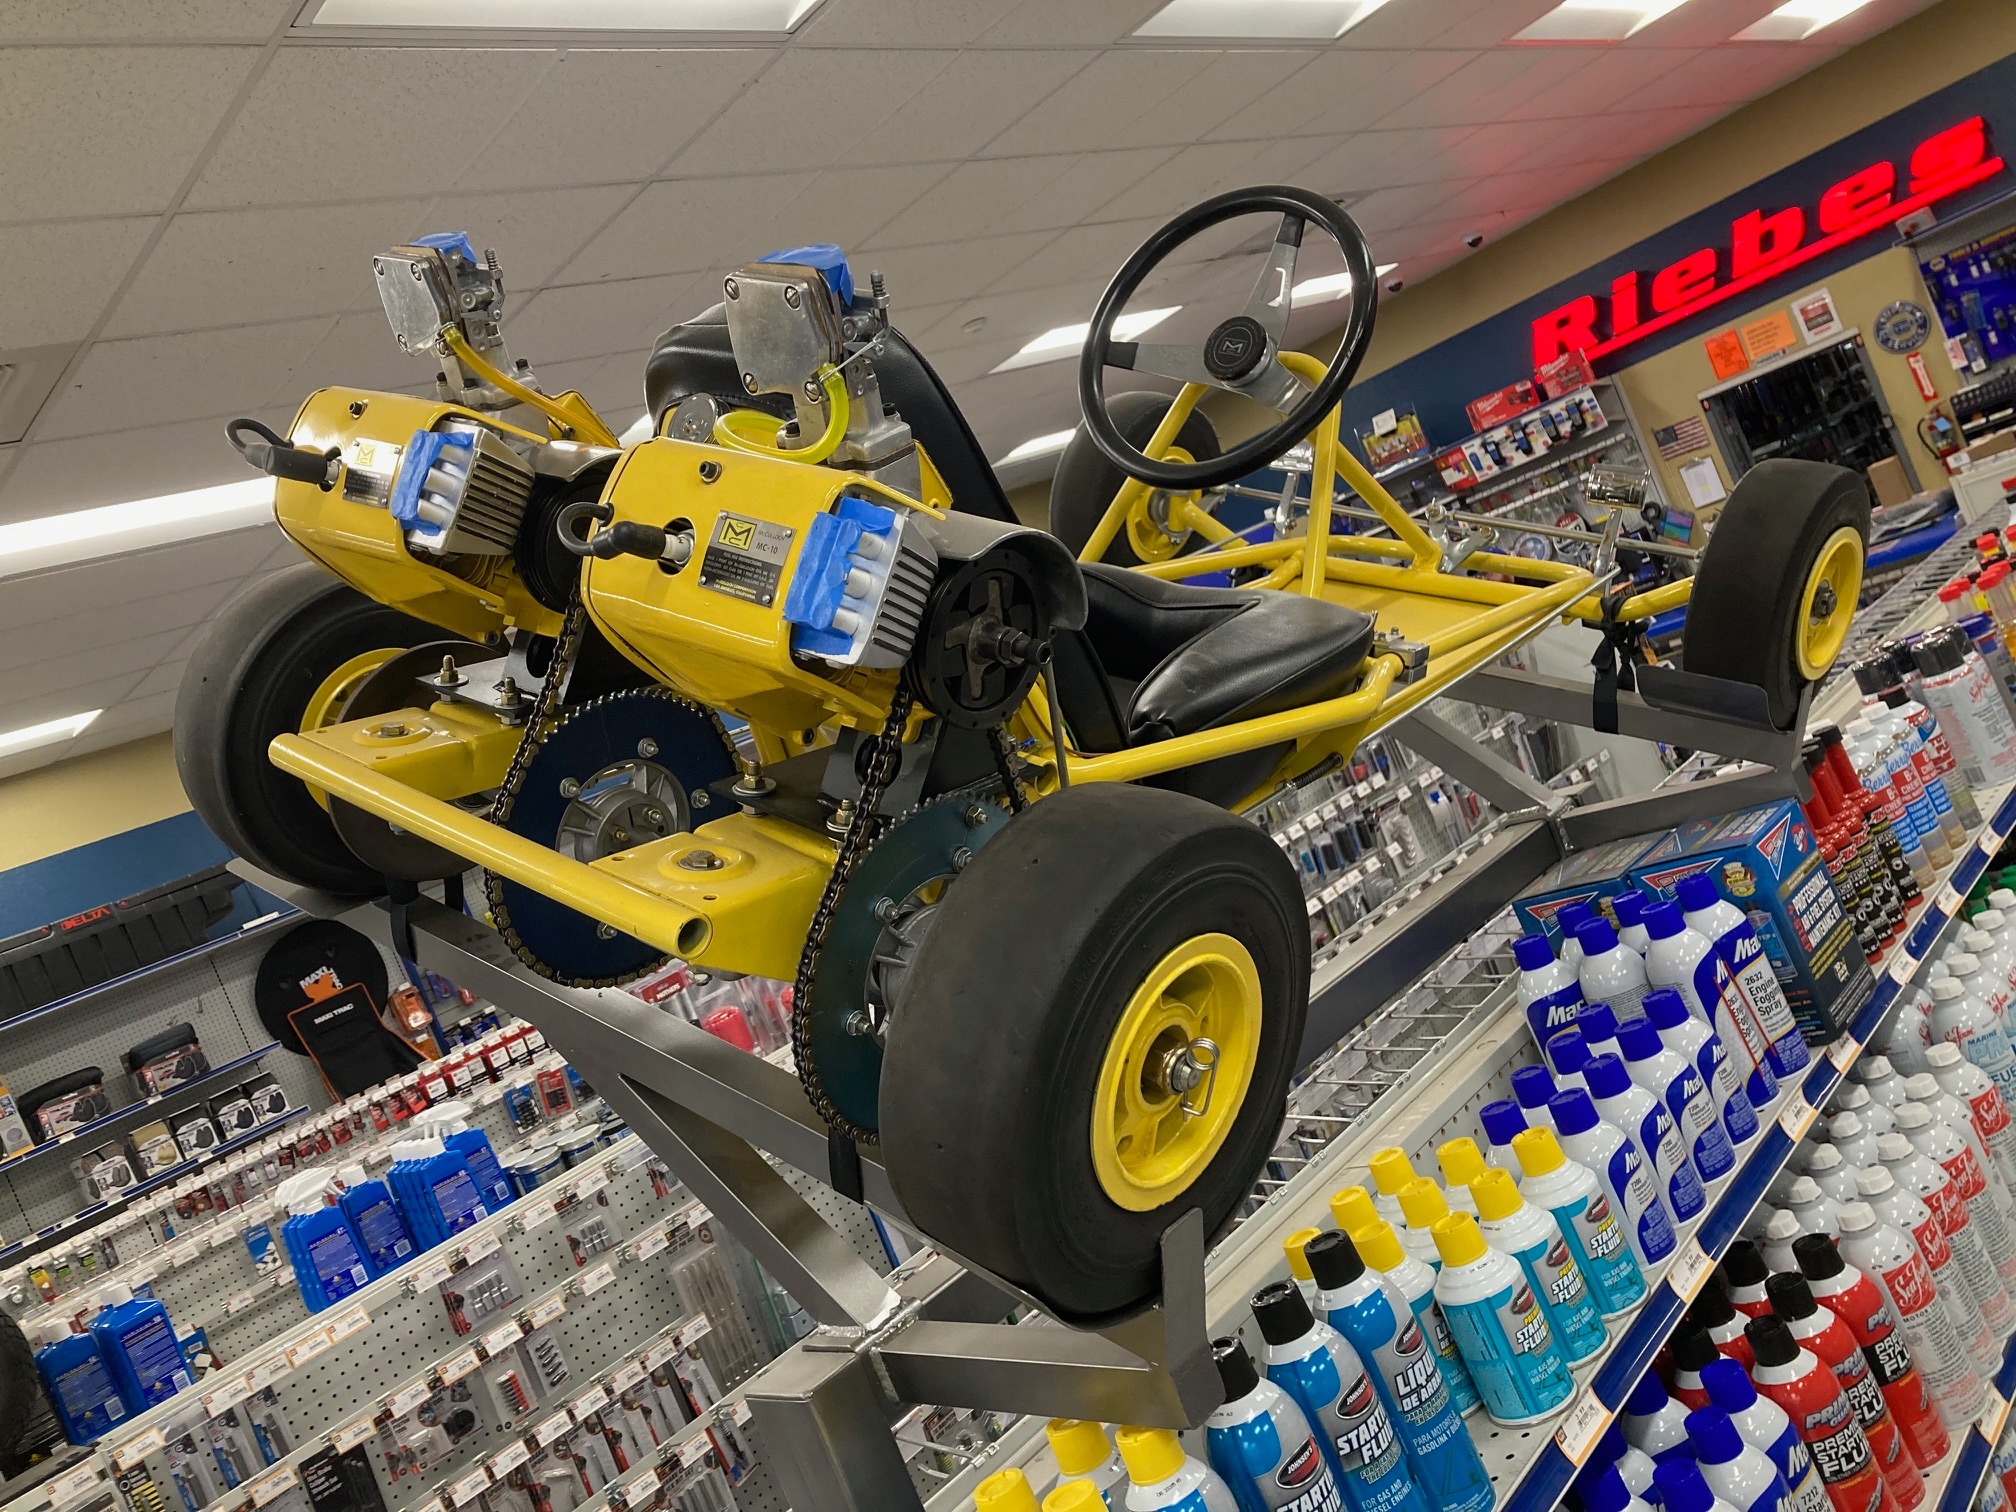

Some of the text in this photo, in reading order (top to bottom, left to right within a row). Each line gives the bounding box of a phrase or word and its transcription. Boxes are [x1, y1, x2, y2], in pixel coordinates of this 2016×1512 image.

[1531, 116, 1988, 372] Riebes
[755, 542, 778, 554] MC-10
[1792, 870, 1829, 915] PROFESSIONAL
[60, 907, 111, 931] DELTA
[299, 966, 329, 989] MAXI
[1744, 971, 1764, 987] 2632
[656, 983, 680, 999] MOTHERS
[1748, 977, 1776, 998] Engine
[1757, 1000, 1784, 1017] Spray
[314, 1012, 333, 1024] MAXI
[1968, 1029, 1997, 1046] MARINE
[1688, 1103, 1700, 1113] 7200
[1662, 1139, 1673, 1150] 7200
[1631, 1177, 1641, 1189] 7200
[1903, 1308, 1927, 1324] MOTOR
[1402, 1394, 1420, 1412] DE
[1413, 1434, 1432, 1447] PARA
[1417, 1434, 1446, 1456] GASOLINA
[1287, 1442, 1314, 1475] JOHNSEN'S
[1362, 1478, 1402, 1510] FOR GAS AND
[1801, 1486, 1820, 1505] 7212
